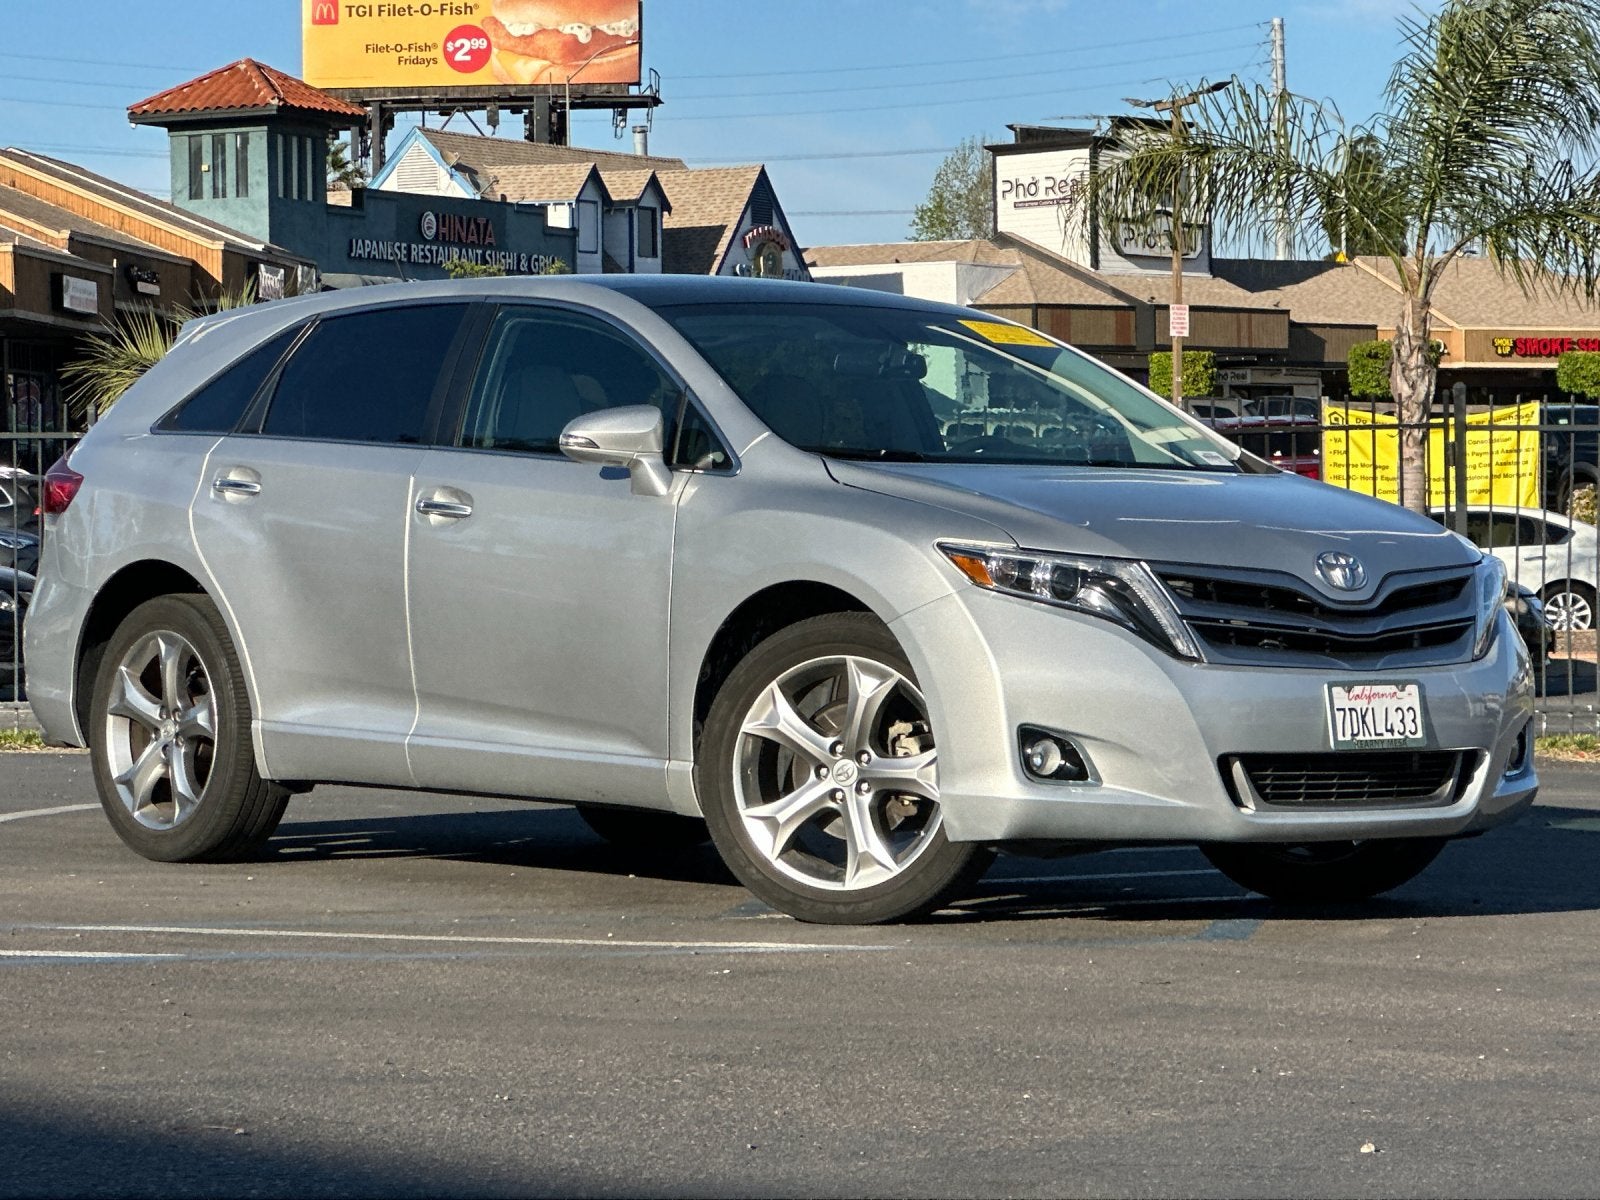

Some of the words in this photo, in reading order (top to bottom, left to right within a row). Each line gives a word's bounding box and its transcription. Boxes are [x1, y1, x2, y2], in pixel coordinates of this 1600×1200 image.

[345, 4, 373, 17] TGI
[397, 56, 438, 68] Fridays
[438, 212, 496, 247] HINATA
[351, 238, 407, 262] JAPANESE
[485, 250, 517, 271] SUSHI
[520, 253, 529, 272] &
[1516, 337, 1573, 355] SMOKE
[1347, 686, 1399, 705] California
[1336, 706, 1418, 738] 7DKL433
